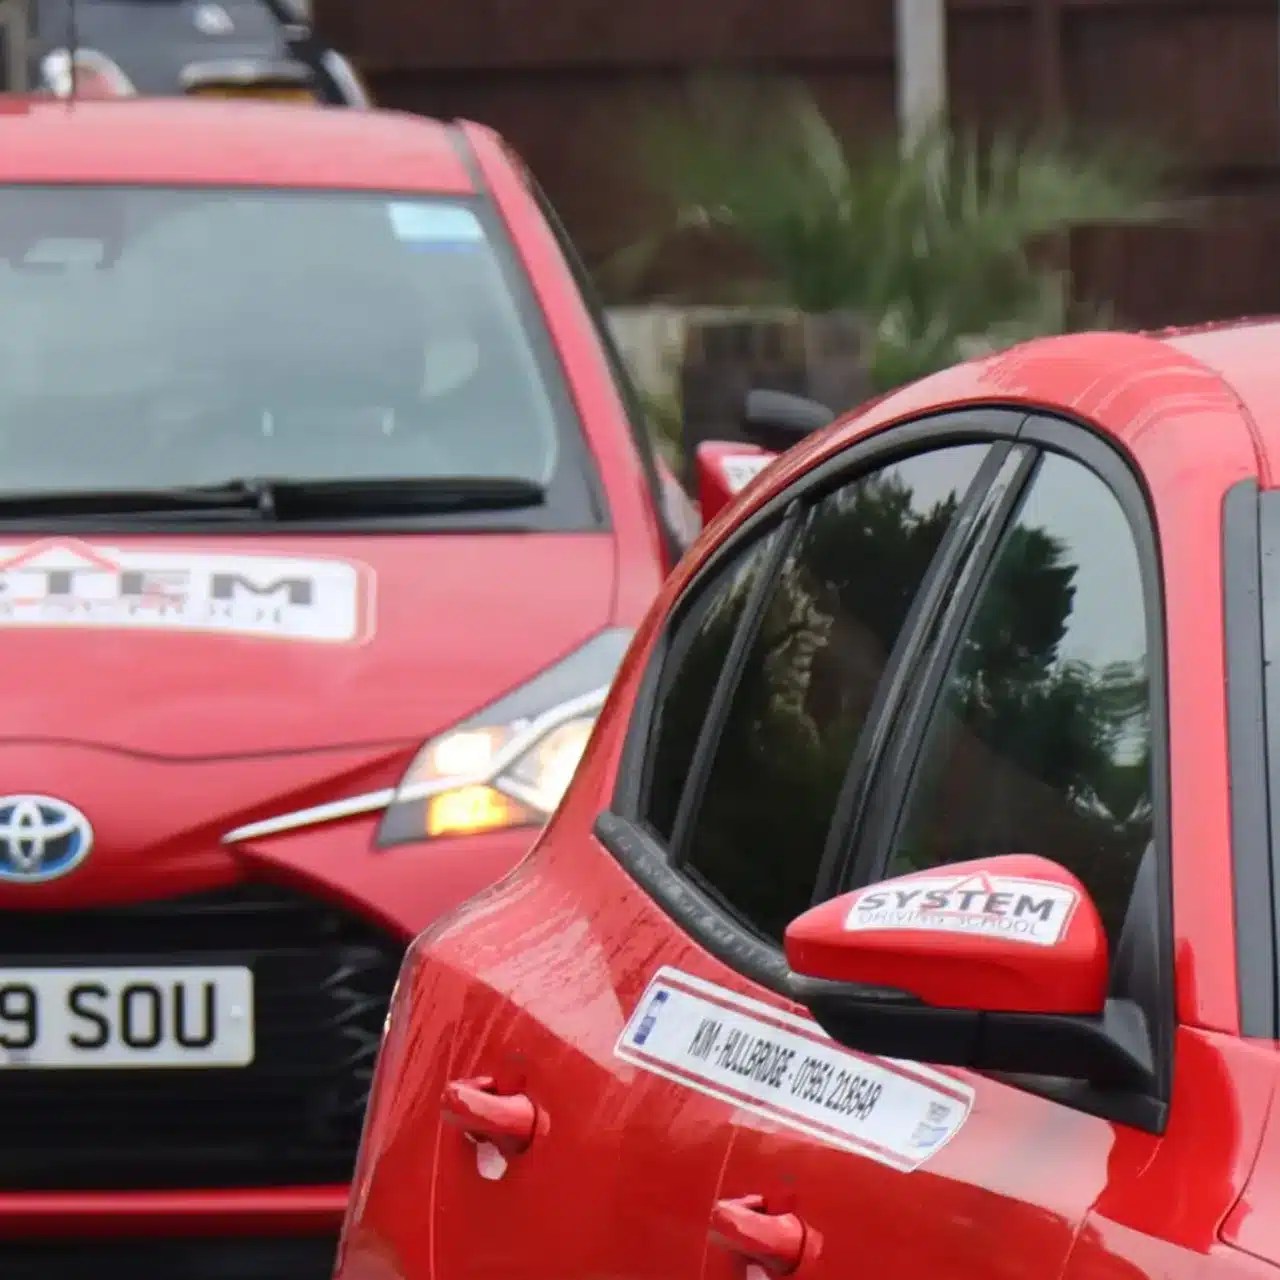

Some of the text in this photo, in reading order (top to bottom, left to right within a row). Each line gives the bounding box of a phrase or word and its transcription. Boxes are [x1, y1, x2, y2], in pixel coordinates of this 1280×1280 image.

[0, 566, 312, 606] TEM
[857, 889, 1056, 922] SYSTEM
[858, 909, 1042, 936] DRIVING SCHOOL
[69, 982, 216, 1050] SOU
[687, 1017, 723, 1061] KIM
